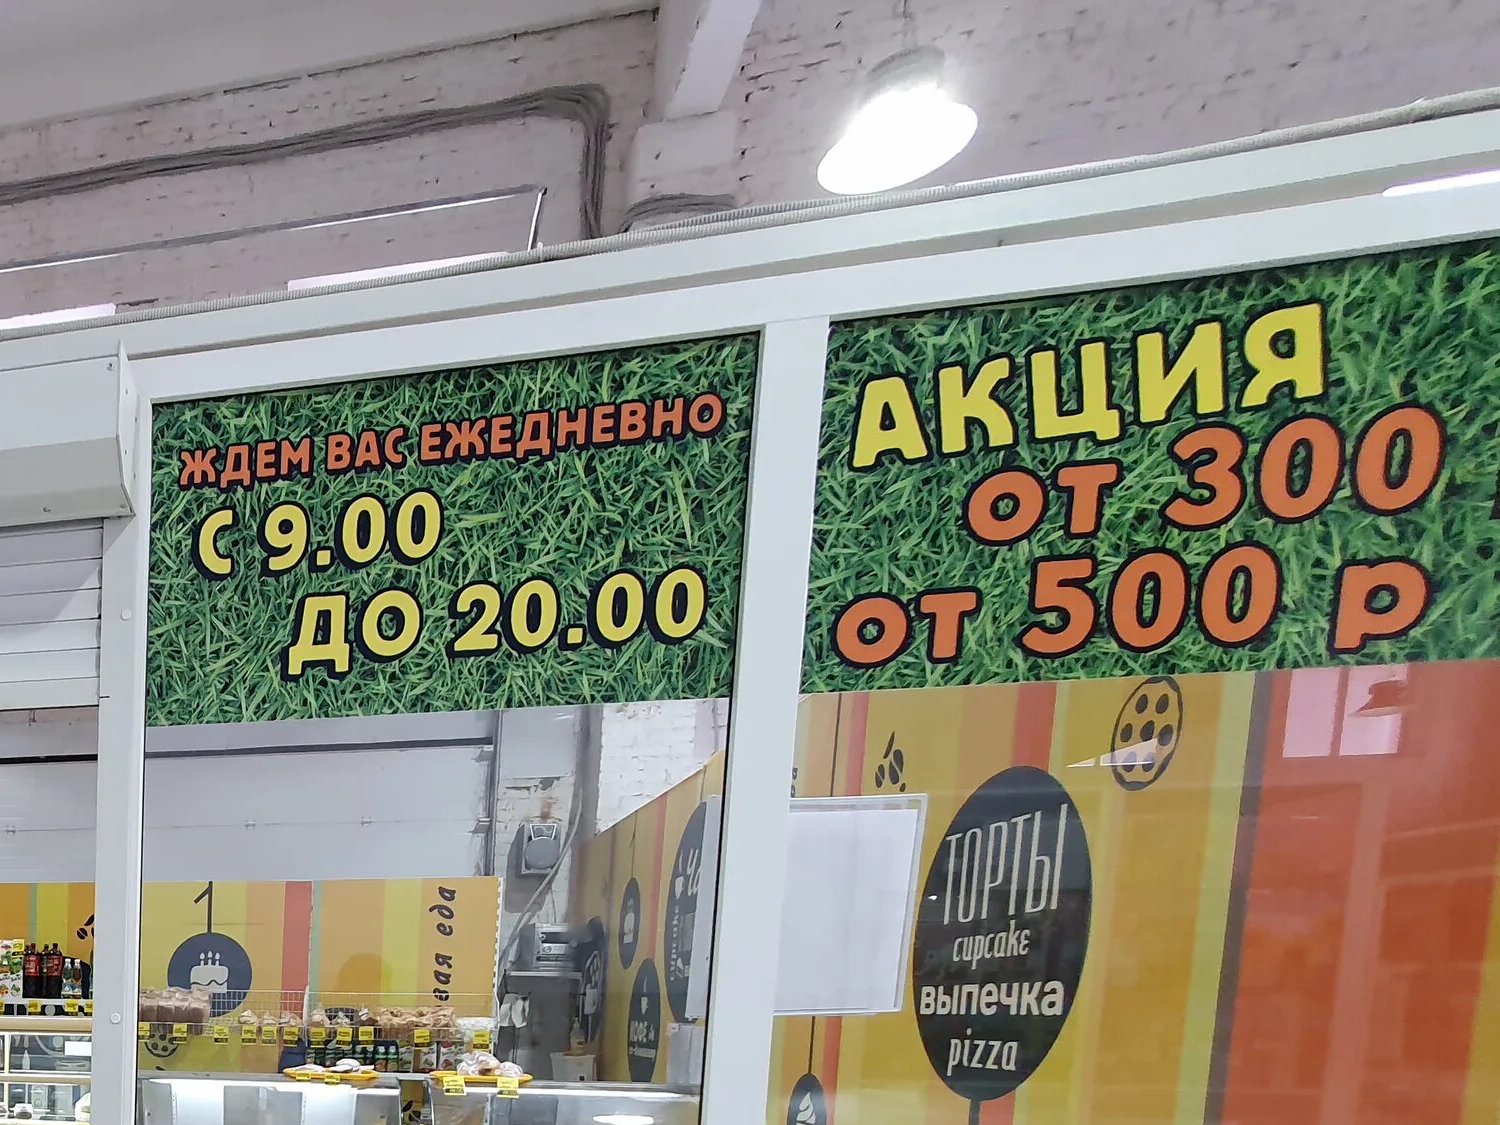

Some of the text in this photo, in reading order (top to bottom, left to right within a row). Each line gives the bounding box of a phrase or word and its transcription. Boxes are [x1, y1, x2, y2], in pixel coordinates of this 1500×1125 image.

[850, 302, 1326, 469] АКЦИЯ
[179, 393, 725, 489] ЖДЕМ ВАС ЕЖЕДНЕВНО
[1162, 405, 1444, 529] 300
[261, 490, 443, 574] 9.00
[287, 566, 707, 676] ДО 20.00
[1019, 545, 1281, 653] 500
[944, 803, 1068, 925] ТОРТЫ
[952, 920, 1031, 970] cupcake
[919, 979, 1066, 1016] выпечка
[947, 1028, 1019, 1077] pizza
